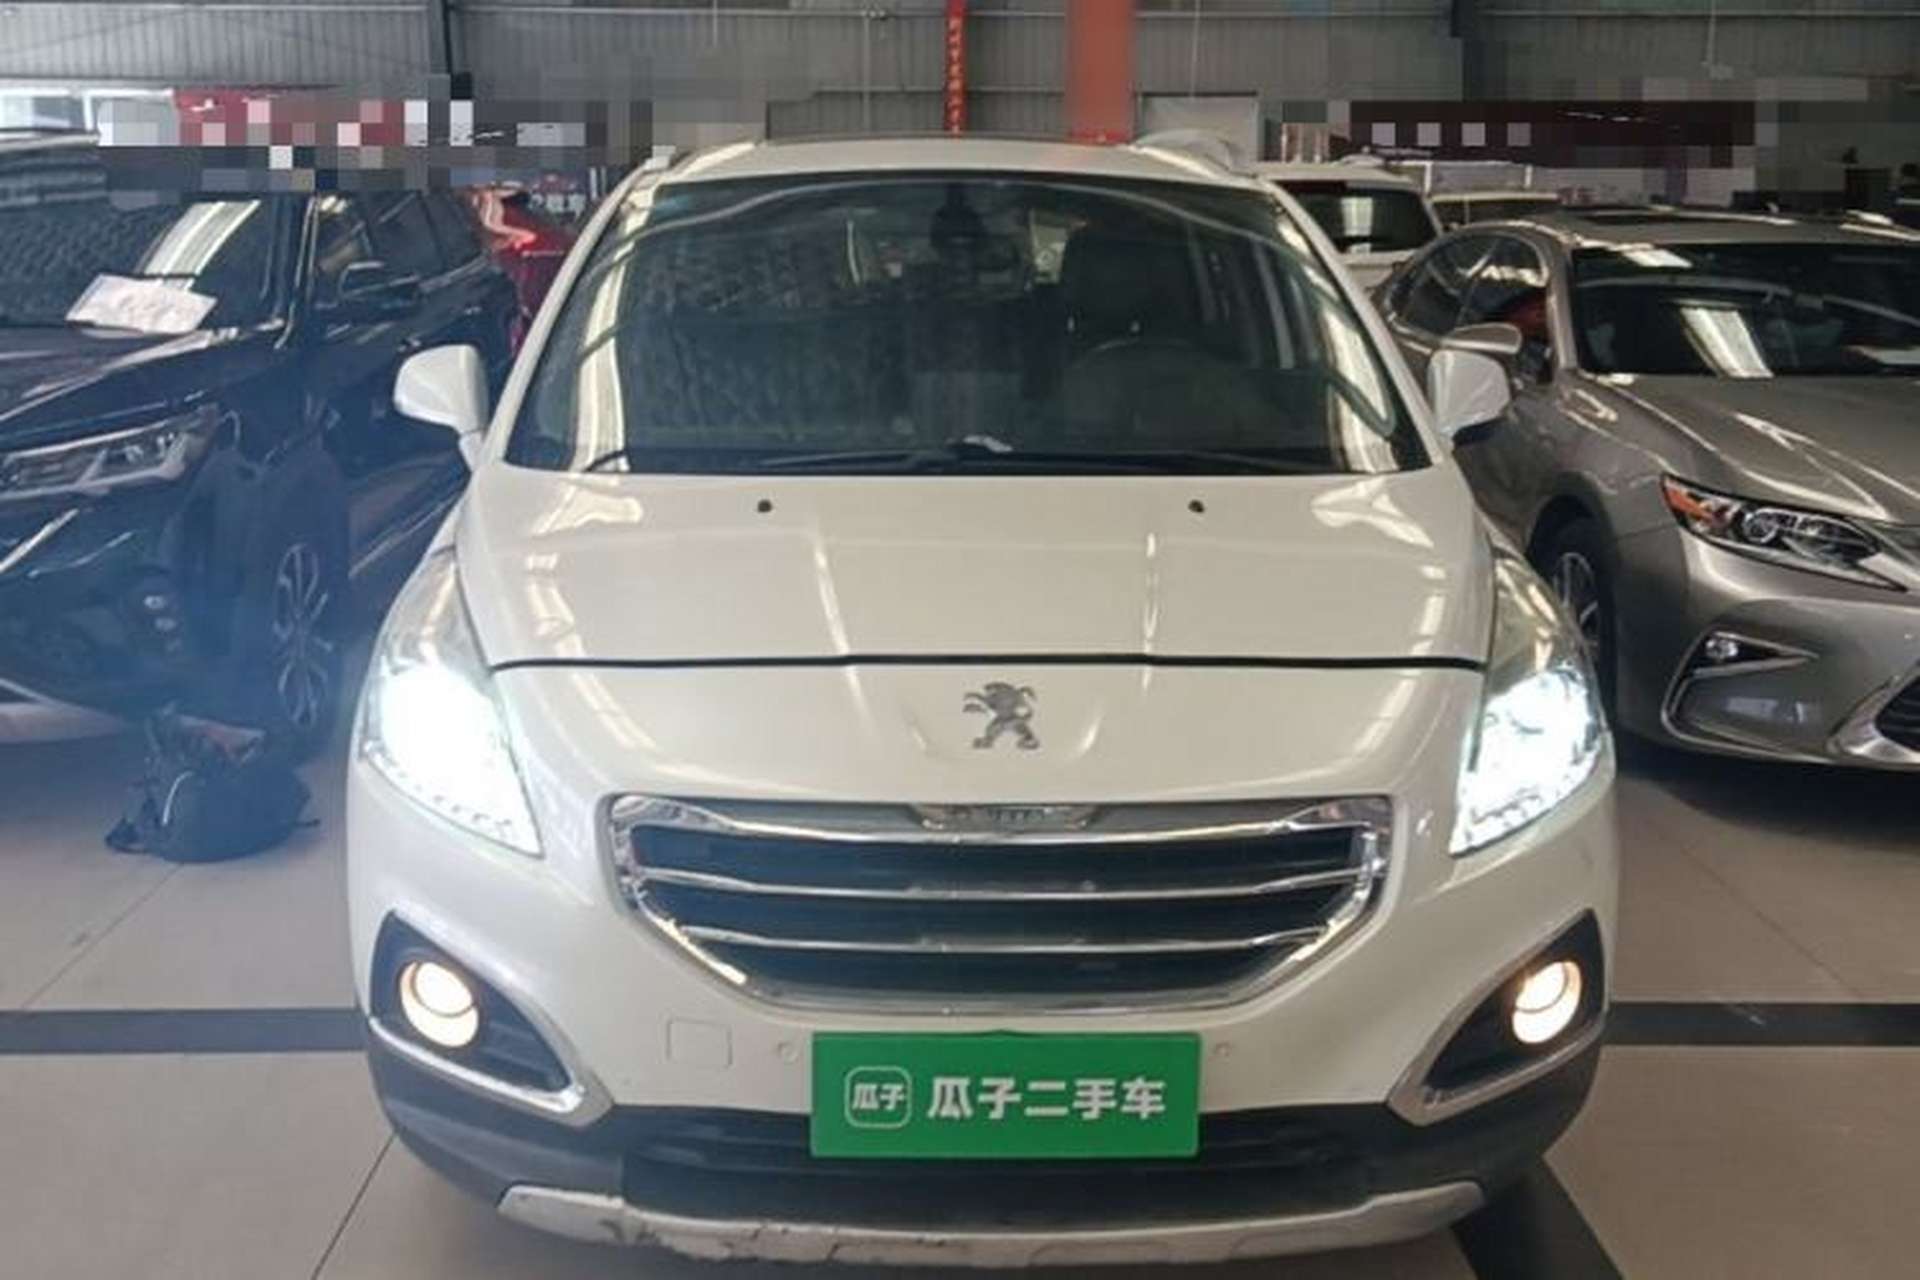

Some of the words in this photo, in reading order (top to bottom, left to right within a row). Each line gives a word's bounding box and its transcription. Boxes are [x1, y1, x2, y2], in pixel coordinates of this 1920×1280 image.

[852, 1083, 905, 1111] 瓜子
[927, 1077, 1166, 1119] 瓜子二手车
